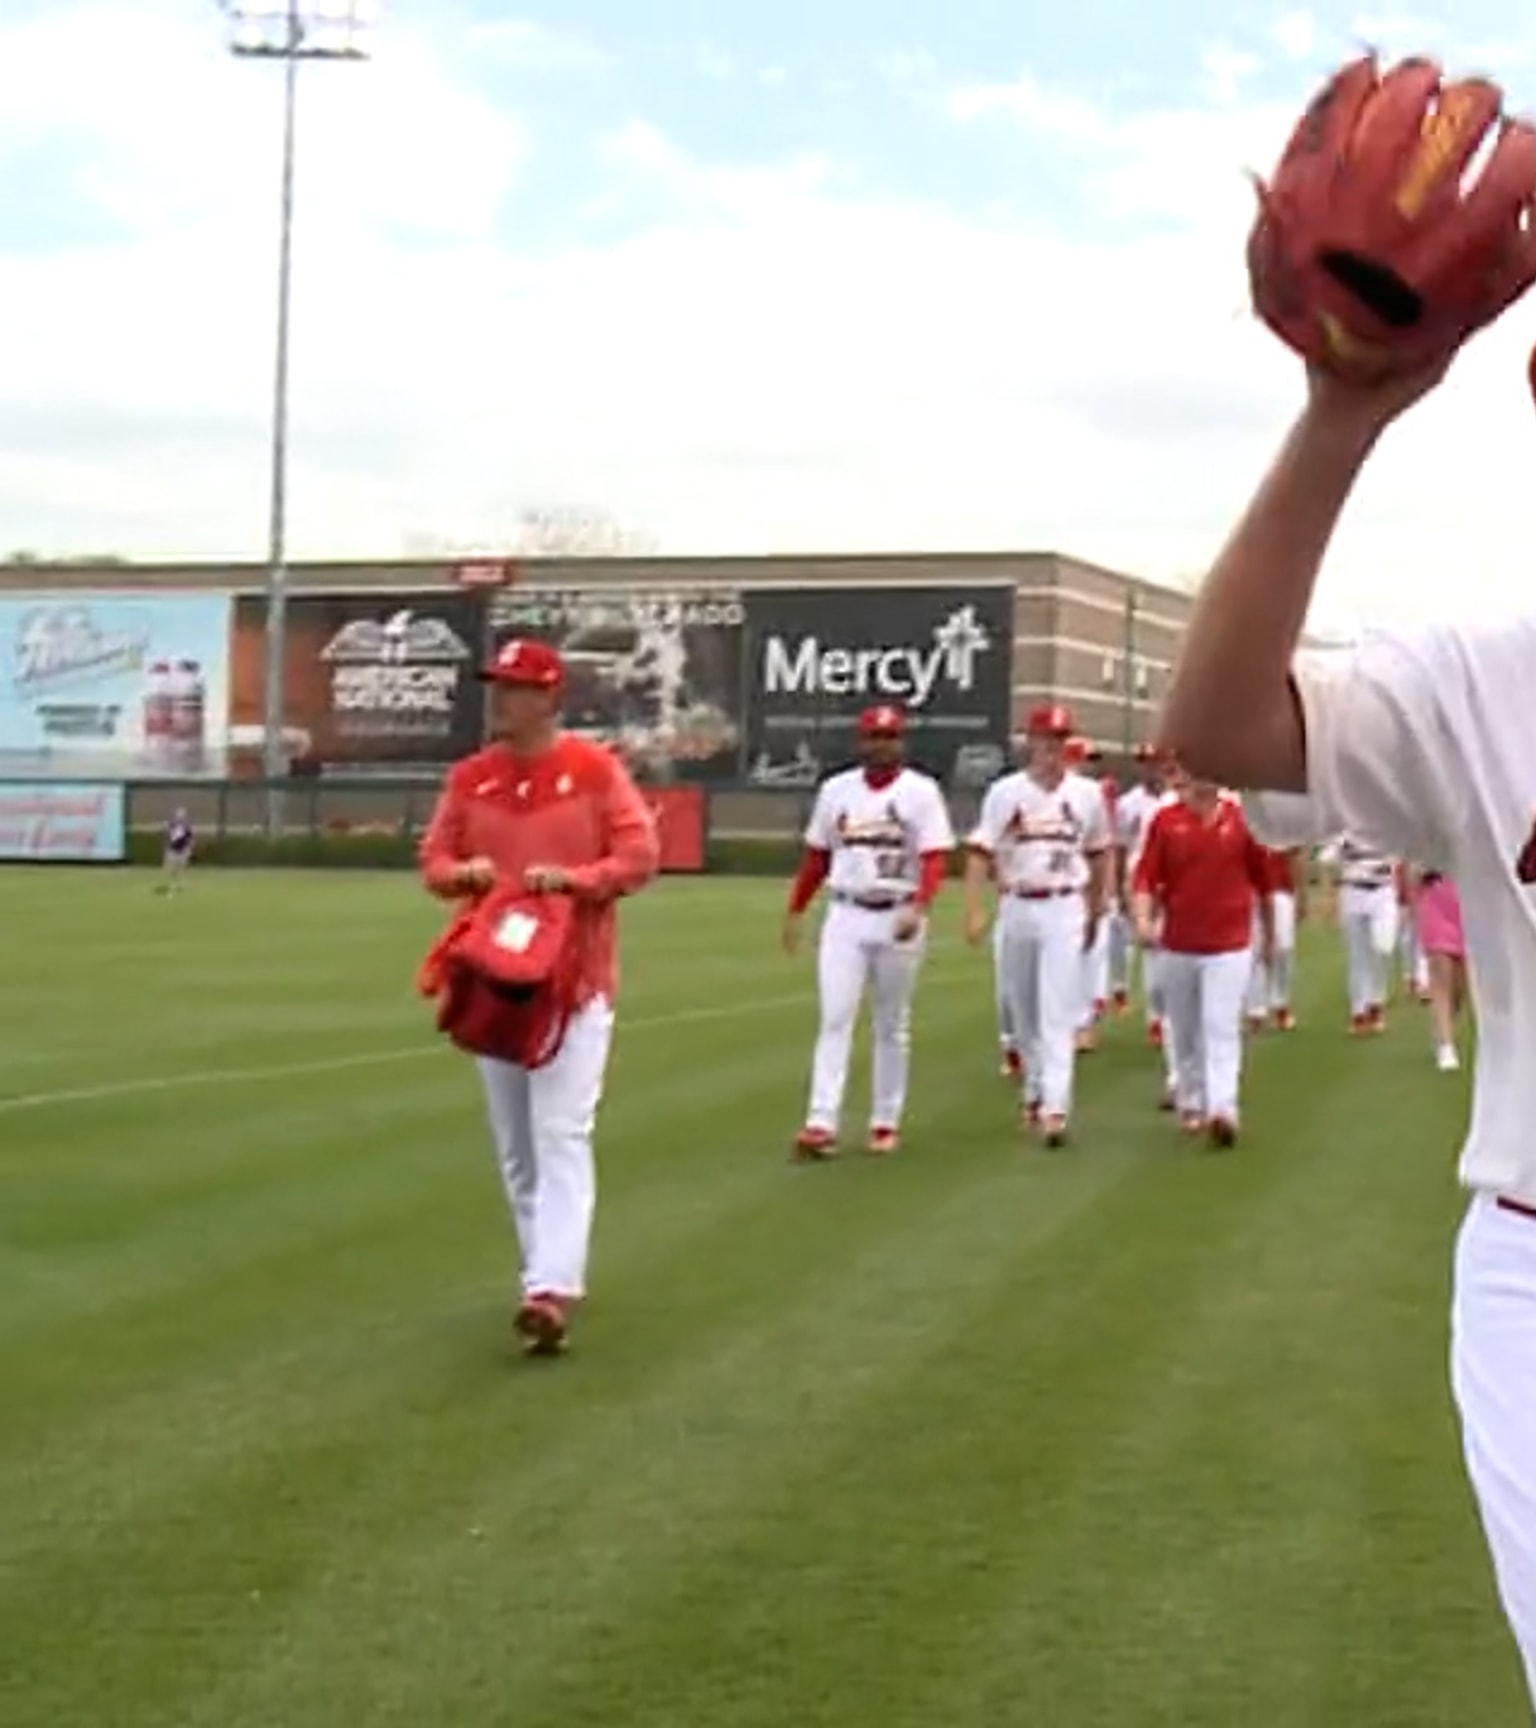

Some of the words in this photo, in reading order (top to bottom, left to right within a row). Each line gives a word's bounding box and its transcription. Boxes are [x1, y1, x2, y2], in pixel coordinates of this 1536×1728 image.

[331, 665, 458, 688] AMERICAN
[766, 635, 942, 706] Mercy
[333, 689, 452, 711] NATIONAL
